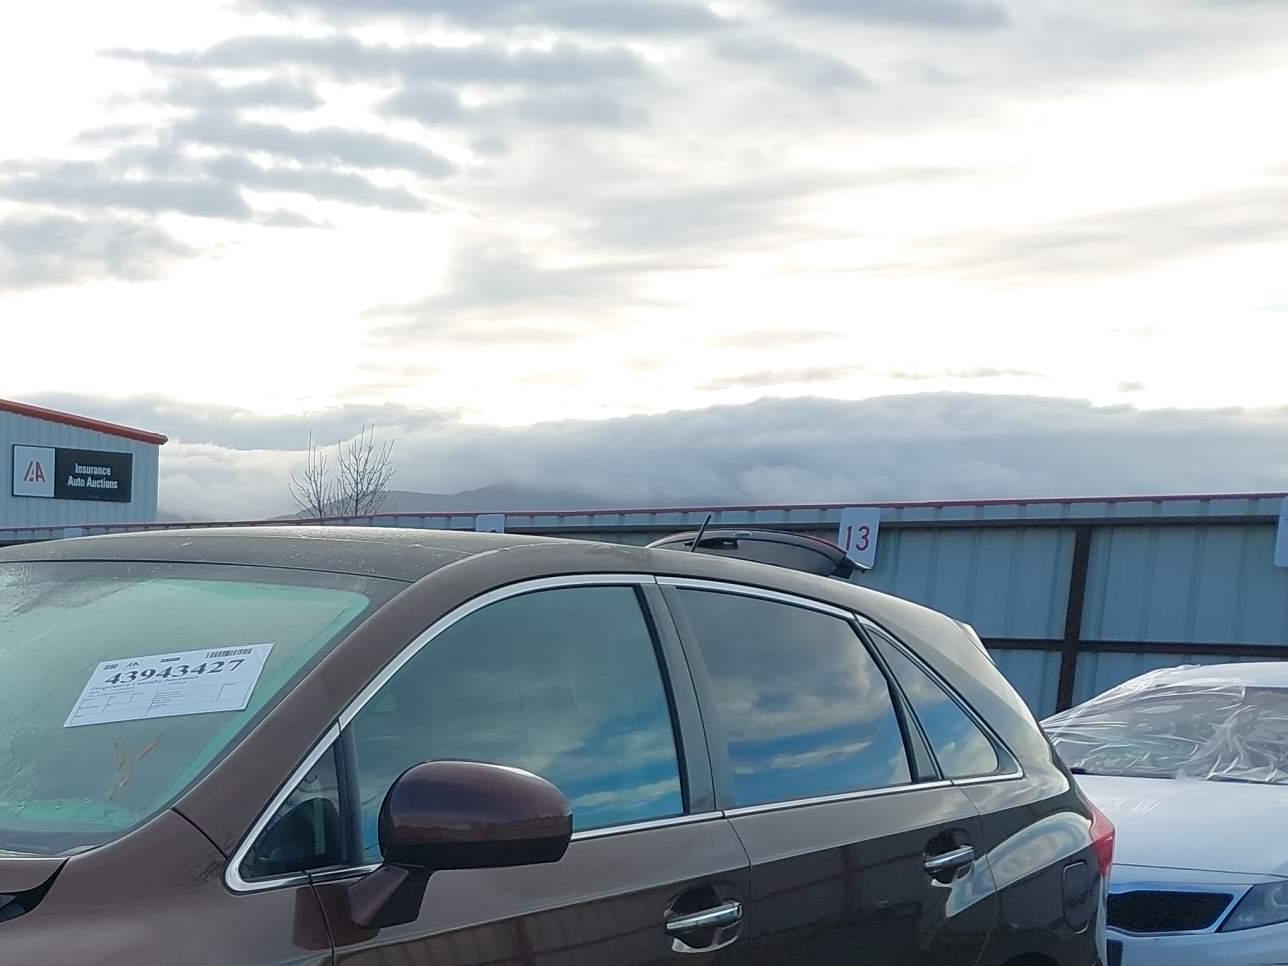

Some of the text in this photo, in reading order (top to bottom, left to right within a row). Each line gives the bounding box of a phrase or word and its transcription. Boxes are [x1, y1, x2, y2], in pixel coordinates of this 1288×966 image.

[75, 463, 112, 476] Insurance
[67, 475, 119, 490] Auto Auctions
[845, 525, 870, 551] 13
[105, 658, 245, 684] 43943427
